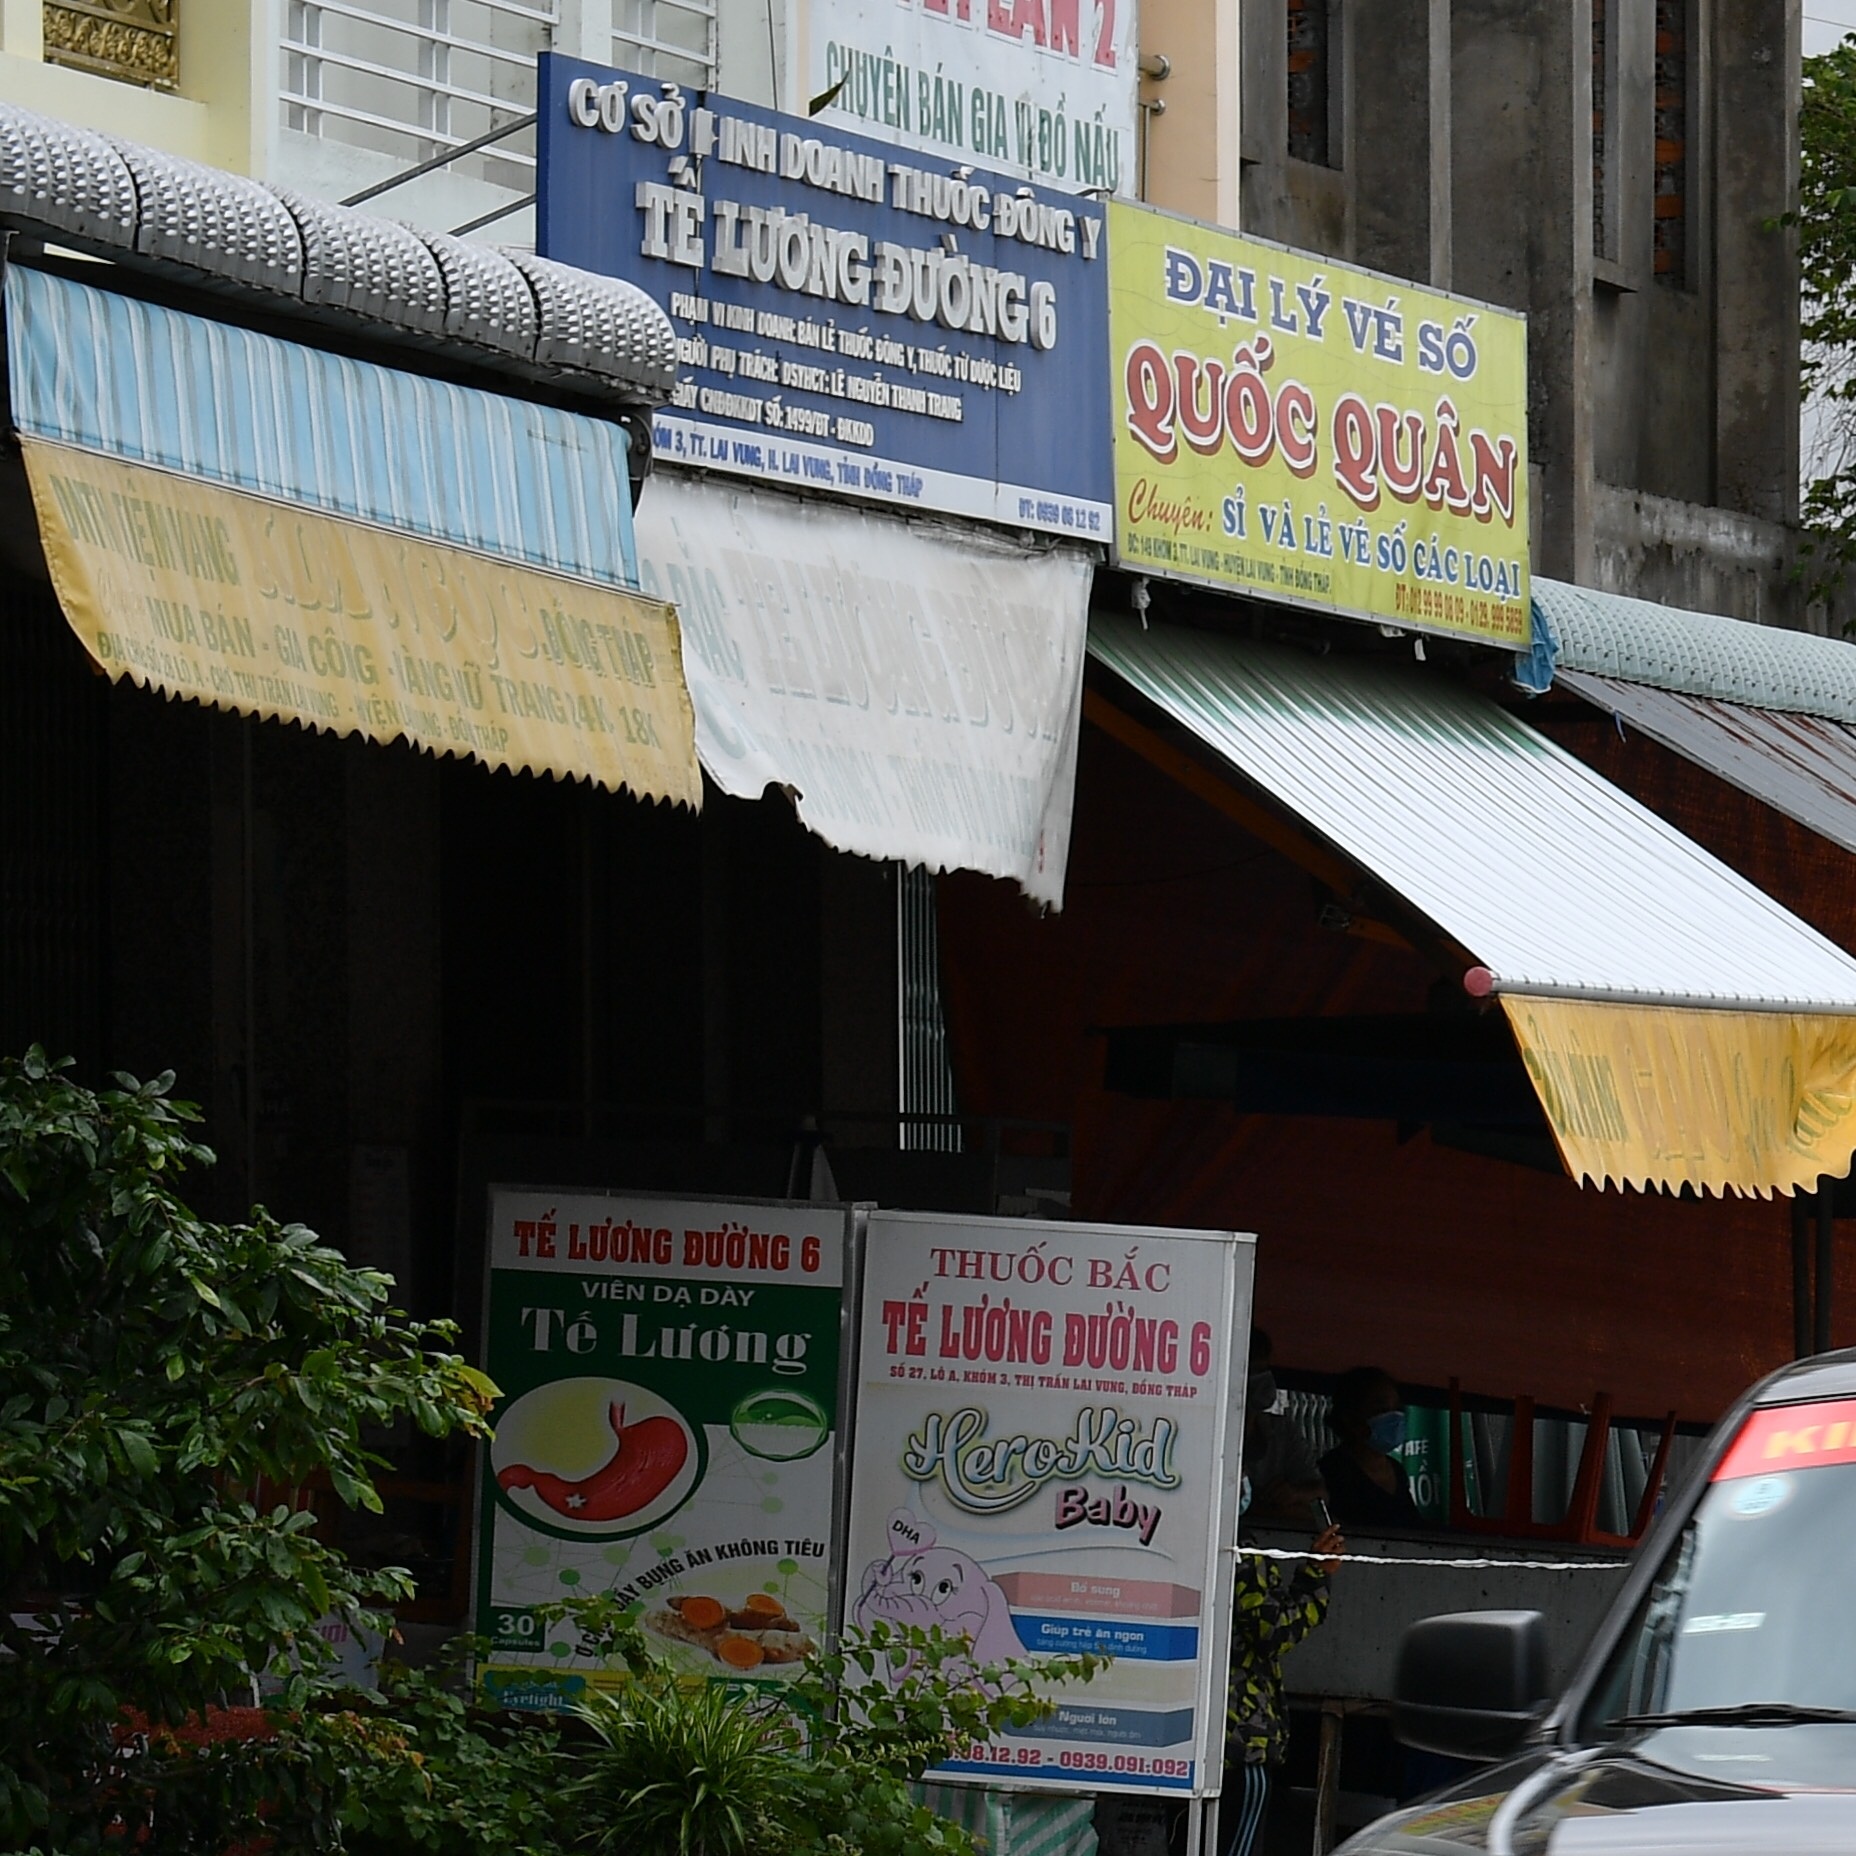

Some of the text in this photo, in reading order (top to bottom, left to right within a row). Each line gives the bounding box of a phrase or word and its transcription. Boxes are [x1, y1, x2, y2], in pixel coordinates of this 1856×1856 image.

[826, 41, 910, 132] CHUYÊN
[918, 62, 963, 148] BÁN
[971, 87, 1008, 161] GIA
[1038, 92, 1066, 177] ĐỒ
[1075, 104, 1118, 190] NẤU
[568, 78, 1101, 260] CƠ SỞ INH DOANH THUỐC ĐÔNG Y
[635, 156, 1057, 351] TẾ LƯƠNG ĐƯỜNG 6
[1165, 245, 1479, 383] ĐẠI LÝ VÉ SỐ
[797, 316, 819, 349] BÁN
[838, 326, 873, 361] THUỐC
[876, 333, 905, 367] ĐÔNG
[918, 345, 952, 378] THUỐC
[1126, 332, 1518, 528] QUỐC QUÂN
[1128, 478, 1212, 536] Chuyên:
[1260, 498, 1297, 551] VÀ
[1304, 506, 1333, 559] LẺ
[1338, 519, 1373, 568] VÉ
[1377, 520, 1408, 575] SỐ
[1413, 533, 1458, 583] CÁC
[1464, 555, 1521, 604] LOẠI
[201, 603, 255, 658] BÁN
[308, 627, 379, 685] CÔNG
[514, 1208, 821, 1273] TẾ LƯƠNG ĐƯỜNG 6
[930, 1241, 1171, 1293] THUỐC BẮC
[582, 1280, 756, 1309] VIÊN DẠ DÀY
[521, 1307, 812, 1376] Tế Lương
[882, 1281, 1212, 1377] TẾ LƯƠNG ĐƯỜNG 6
[890, 1362, 906, 1379] SỐ
[930, 1366, 945, 1381] LÔ
[963, 1366, 998, 1386] KHÓM
[1014, 1374, 1035, 1391] THỊ
[1038, 1372, 1070, 1390] TRẤN
[1073, 1378, 1092, 1391] LAI
[1096, 1380, 1129, 1396] VUNG,
[1132, 1379, 1163, 1396] ĐỒNG
[1166, 1383, 1198, 1398] THÁP
[1404, 1438, 1429, 1456] AFE
[891, 1519, 921, 1545] DHA
[1054, 1483, 1162, 1546] Baby
[636, 1538, 826, 1591] BỤNG ĂN KHÔNG TIÊU
[1091, 1586, 1120, 1598] sung
[497, 1614, 535, 1636] 30
[1041, 1623, 1069, 1638] Giúp
[1115, 1631, 1144, 1643] ngon
